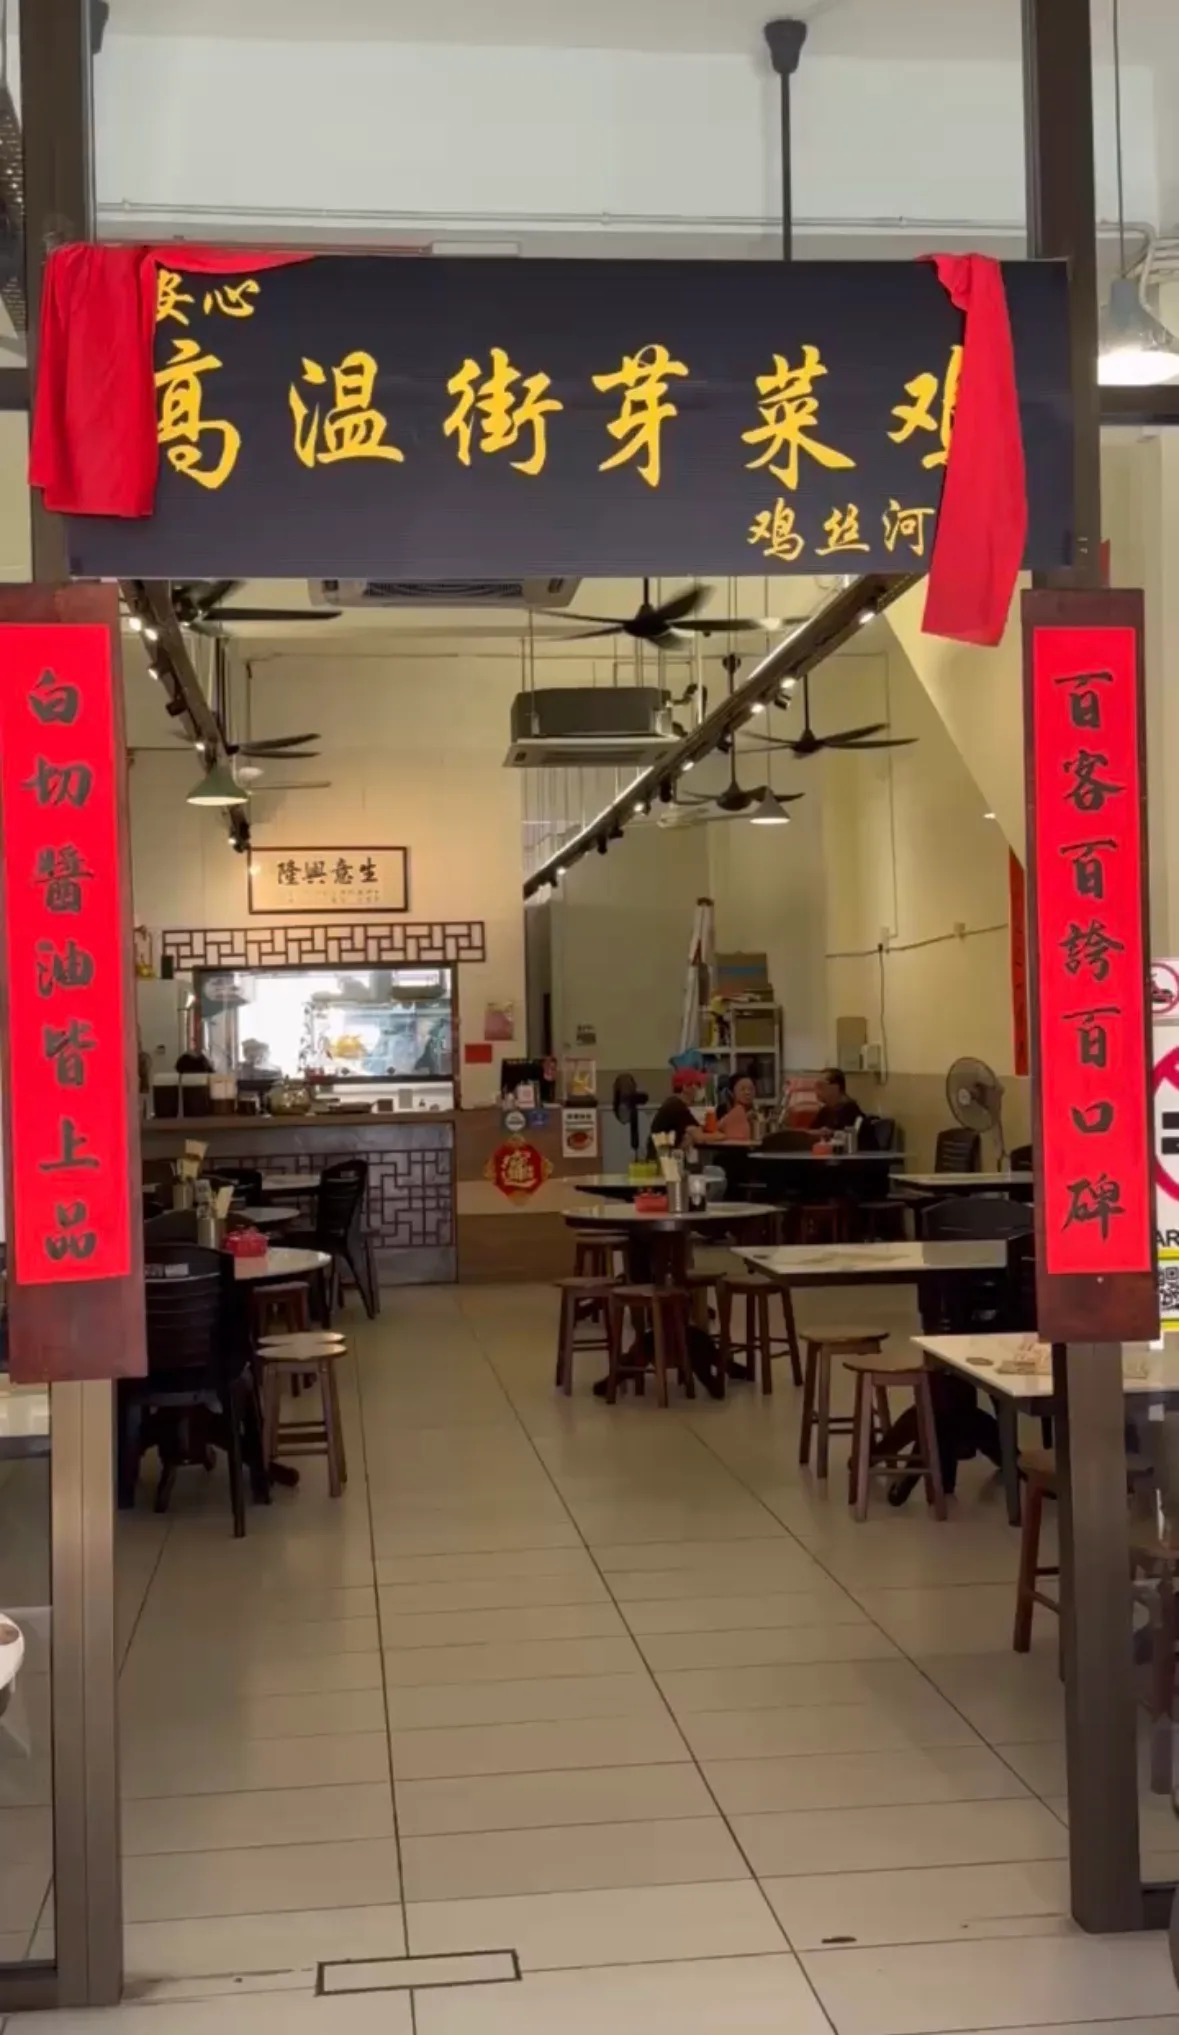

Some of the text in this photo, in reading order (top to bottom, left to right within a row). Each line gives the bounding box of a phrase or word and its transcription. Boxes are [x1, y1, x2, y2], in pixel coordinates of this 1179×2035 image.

[747, 497, 936, 562] 鸡丝河
[1054, 671, 1126, 1241] 百客百誇百口碑
